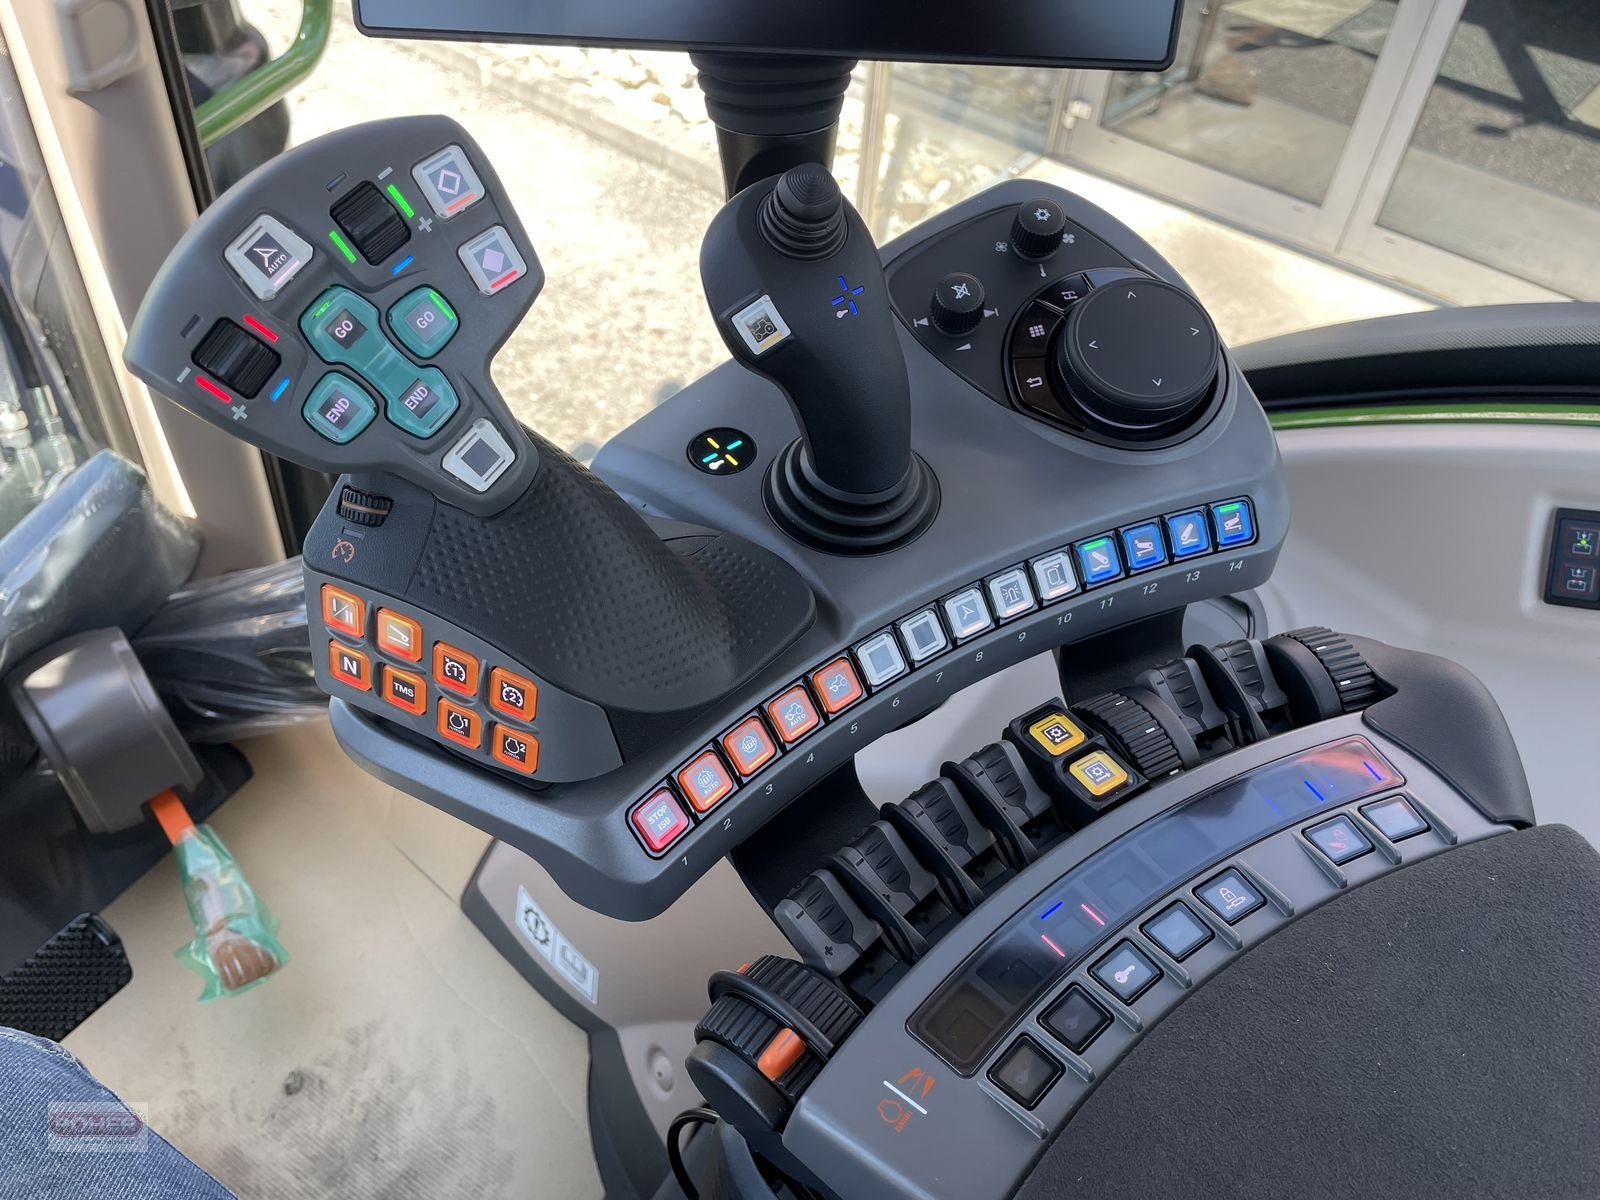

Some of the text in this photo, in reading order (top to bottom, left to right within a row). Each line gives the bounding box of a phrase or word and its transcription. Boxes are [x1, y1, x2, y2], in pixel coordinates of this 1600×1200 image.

[267, 254, 287, 275] AUTO
[416, 310, 435, 329] GO
[334, 319, 354, 339] GO
[403, 385, 428, 411] END
[325, 397, 350, 424] END
[1229, 559, 1244, 572] 14
[1185, 570, 1201, 583] 13
[1142, 583, 1158, 595] 12
[1100, 597, 1114, 610] 11
[1056, 612, 1072, 626] 10
[1018, 631, 1026, 643] 9
[975, 651, 984, 662] 8
[343, 655, 357, 676] N
[935, 671, 943, 683] 7
[393, 681, 414, 698] TMS
[509, 692, 516, 703] 2
[892, 696, 900, 708] 6
[790, 713, 806, 727] AUTO
[850, 722, 858, 734] 5
[519, 743, 526, 753] 2
[806, 752, 814, 763] 4
[704, 780, 719, 795] AUTO
[765, 783, 773, 795] 3
[647, 805, 668, 825] STOP
[657, 816, 672, 831] ISB
[723, 817, 732, 831] 2
[681, 856, 689, 867] 1
